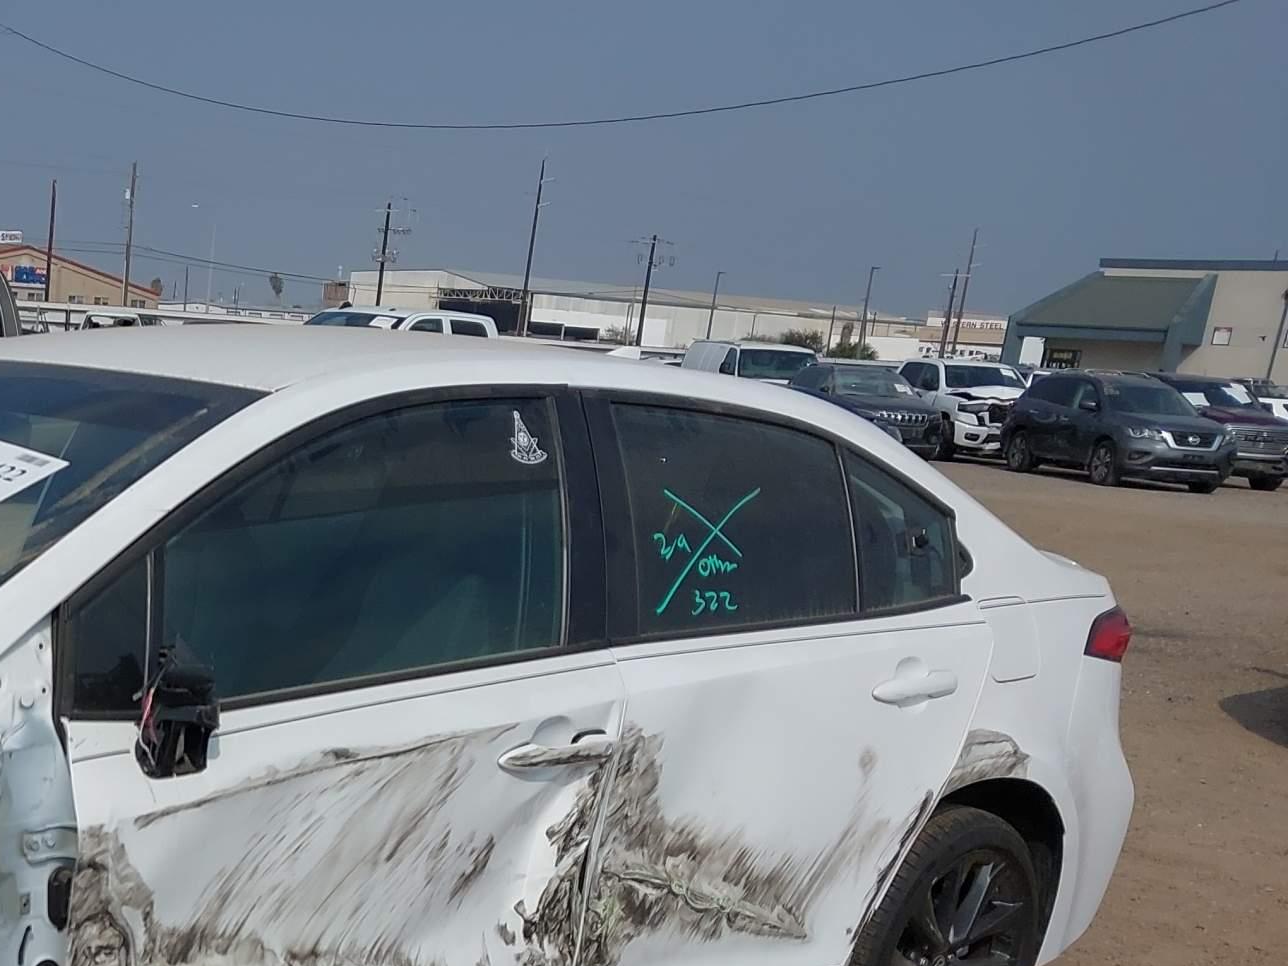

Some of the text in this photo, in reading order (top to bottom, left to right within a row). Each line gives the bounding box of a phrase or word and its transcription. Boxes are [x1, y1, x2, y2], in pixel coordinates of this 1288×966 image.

[941, 320, 1004, 330] WSERN STEEL
[691, 589, 738, 616] 322
